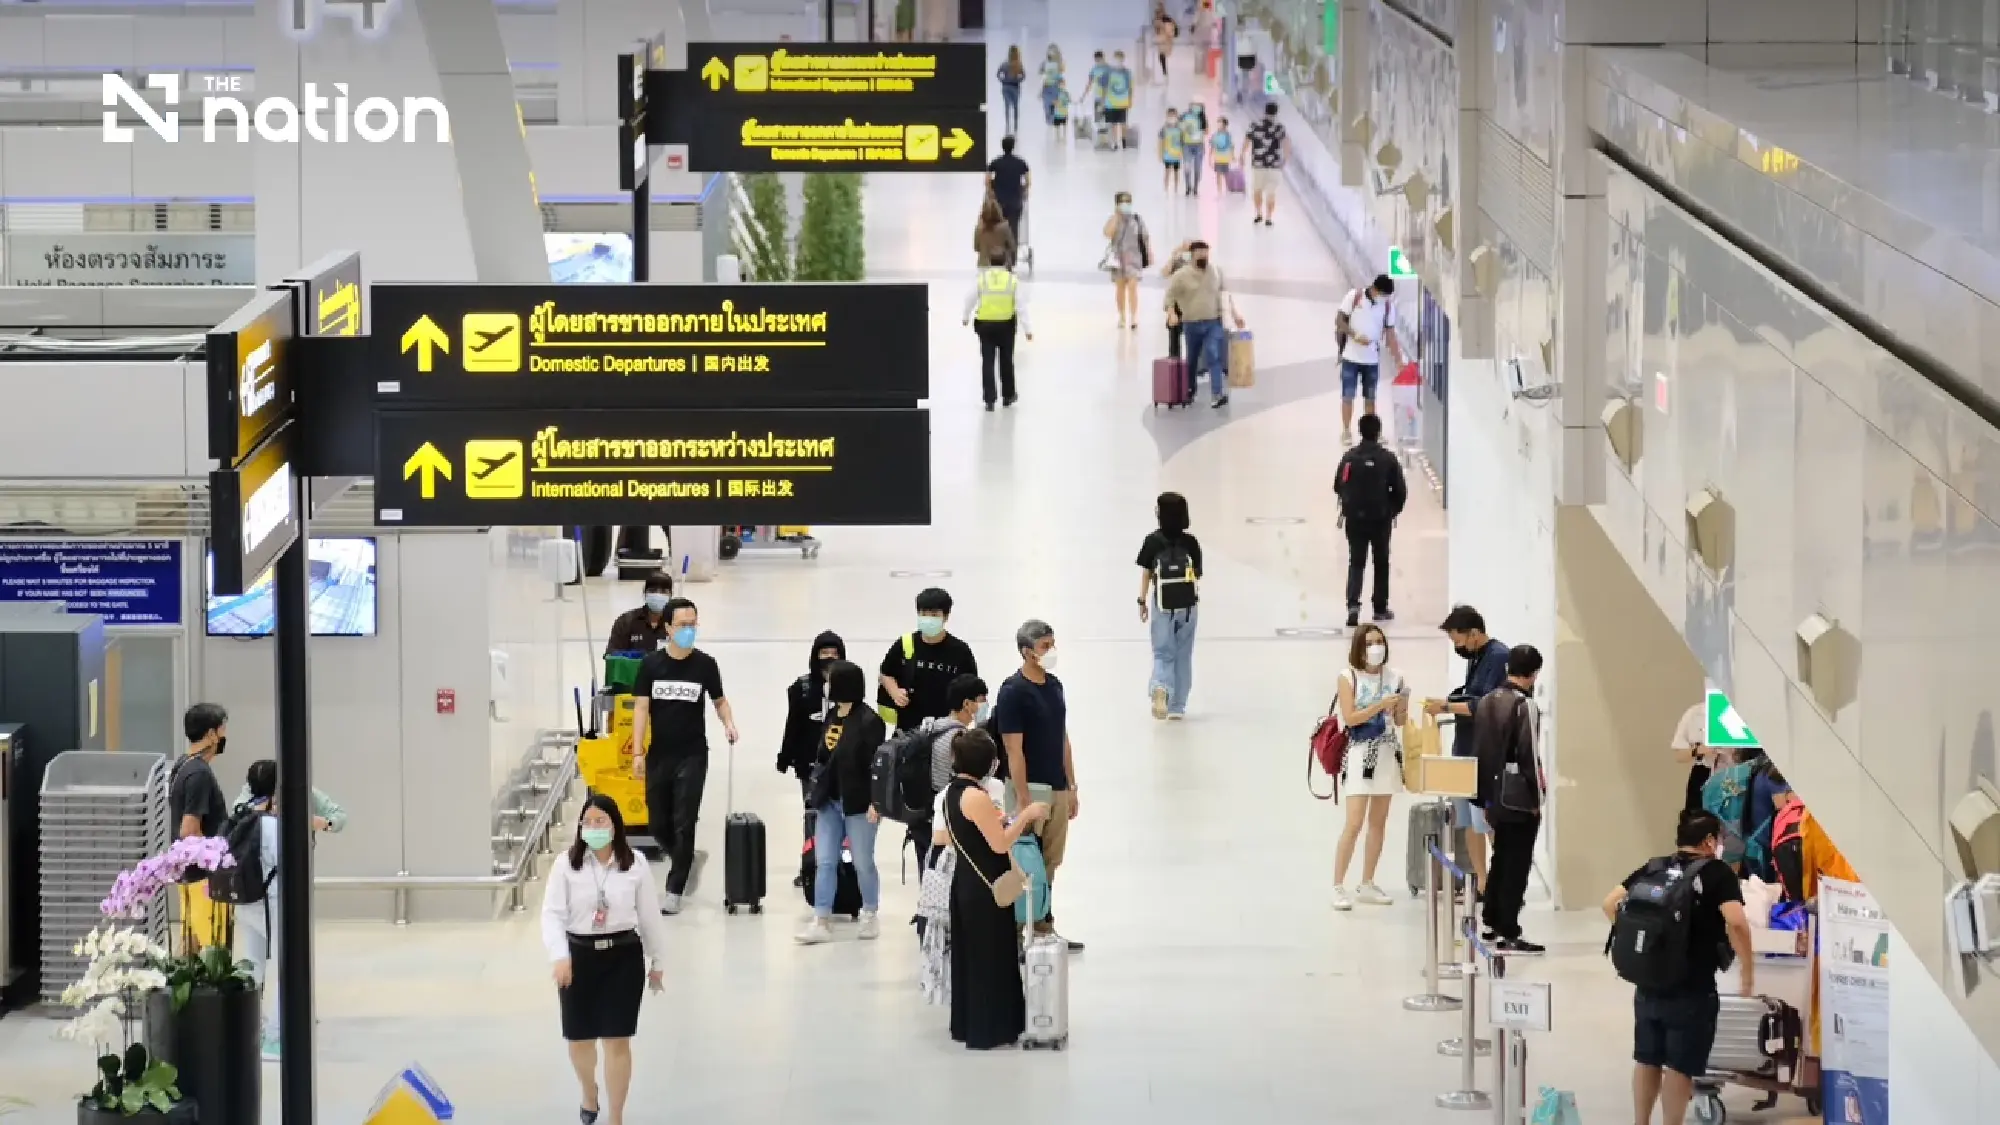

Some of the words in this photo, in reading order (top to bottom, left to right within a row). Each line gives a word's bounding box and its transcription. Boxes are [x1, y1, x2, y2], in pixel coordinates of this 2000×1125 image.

[44, 244, 227, 270] ห้องตรวจสัมภาระ
[528, 299, 828, 344] ผู้โดยสารขาออกภายในประเทศ
[529, 356, 600, 373] Domestic
[603, 356, 686, 376] Departures
[704, 354, 770, 373] 国内出发
[531, 426, 836, 468] ผู้โดยสารขาออกระหว่างประเทศ
[531, 479, 624, 498] International
[627, 479, 710, 500] Departures
[727, 479, 794, 498] 国际出发
[654, 684, 699, 698] adidas
[1504, 1001, 1530, 1015] EXIT
